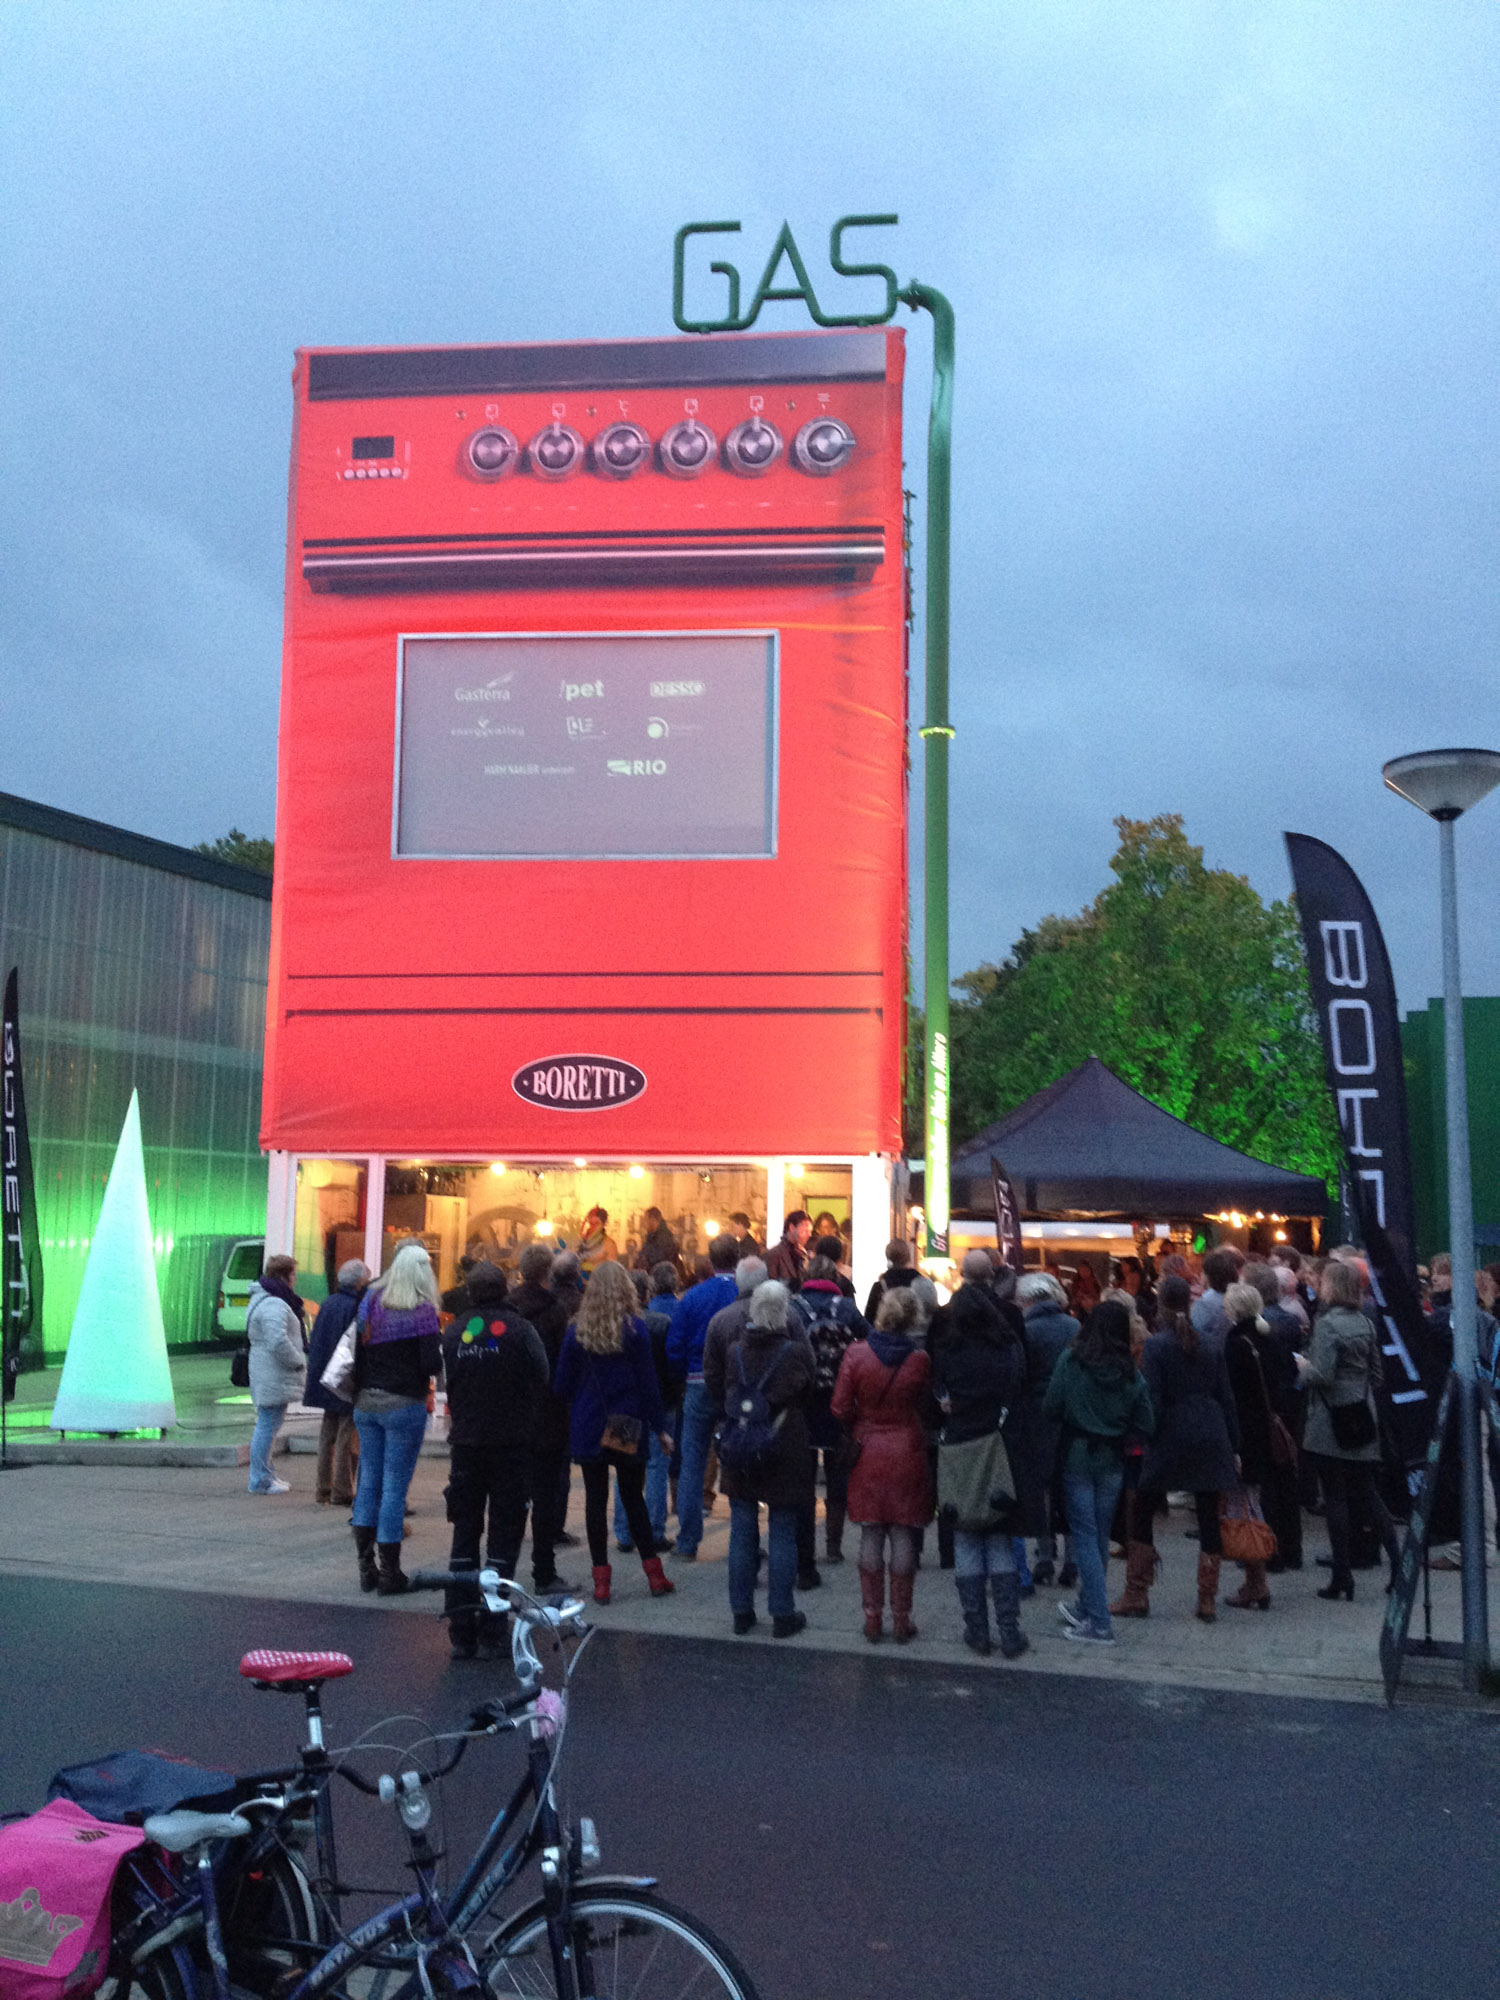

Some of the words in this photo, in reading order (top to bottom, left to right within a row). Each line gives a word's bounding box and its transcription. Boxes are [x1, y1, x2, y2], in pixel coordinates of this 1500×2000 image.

[673, 213, 898, 333] GAS
[633, 759, 667, 775] RIO
[533, 1065, 626, 1101] BORETTI
